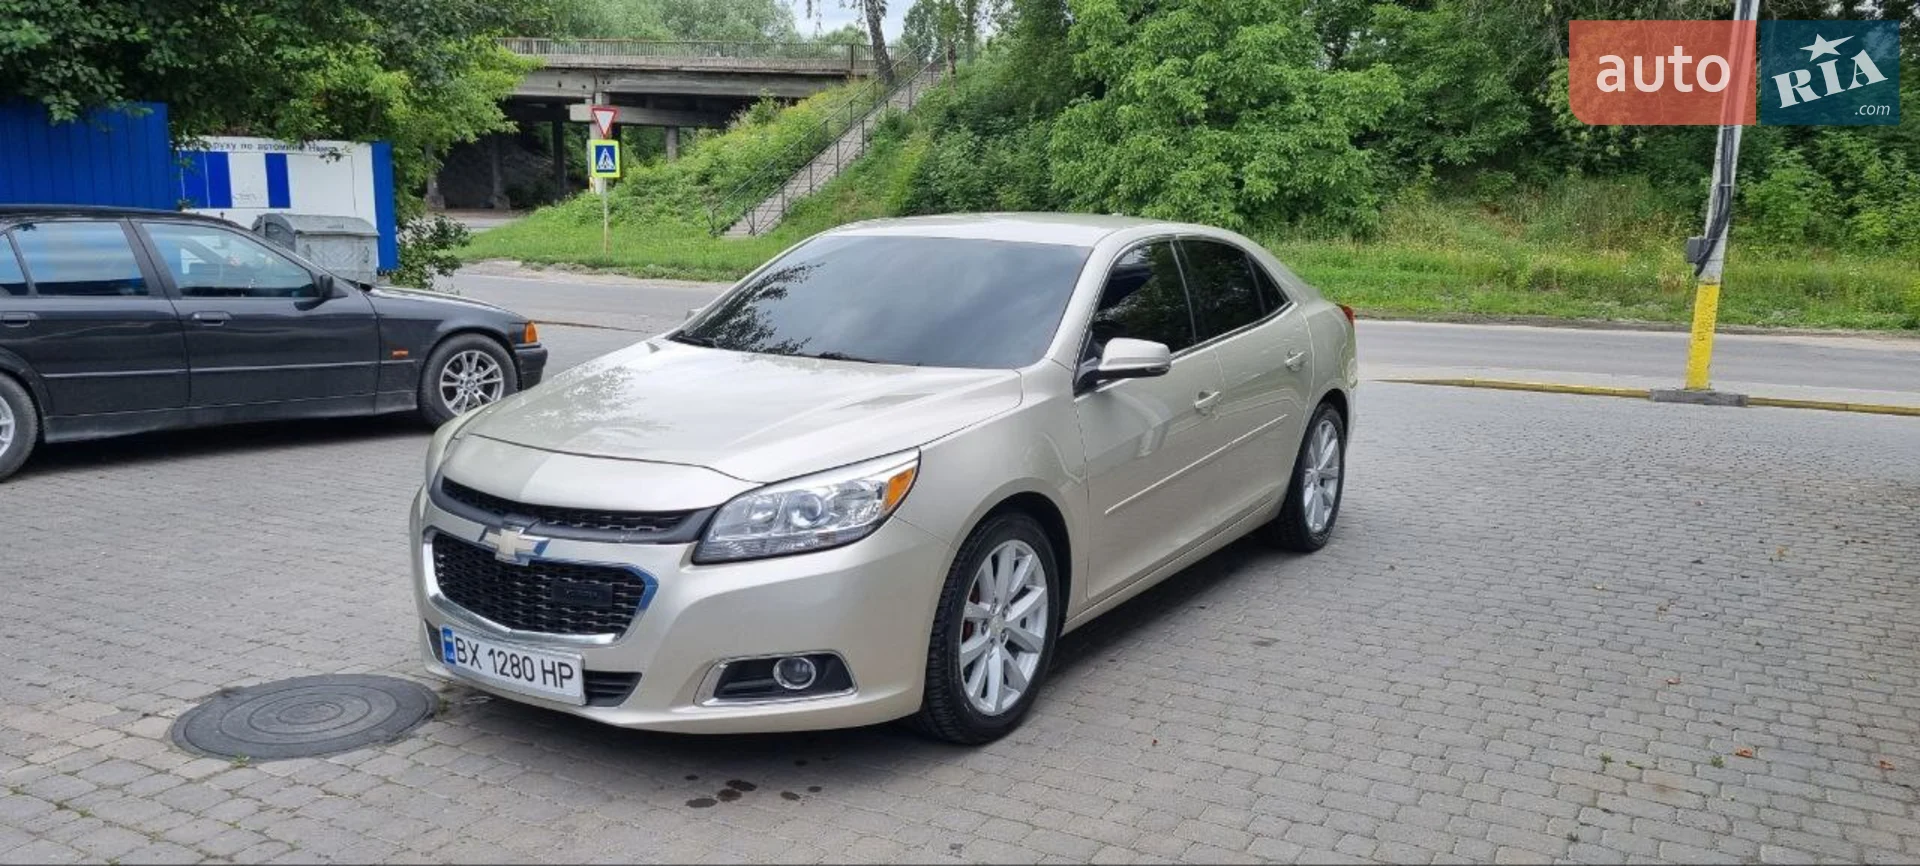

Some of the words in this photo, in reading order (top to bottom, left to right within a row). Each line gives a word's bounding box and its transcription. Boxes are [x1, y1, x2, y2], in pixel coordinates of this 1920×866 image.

[455, 636, 482, 670] BX
[488, 648, 535, 683] 1280
[541, 659, 574, 689] HP
